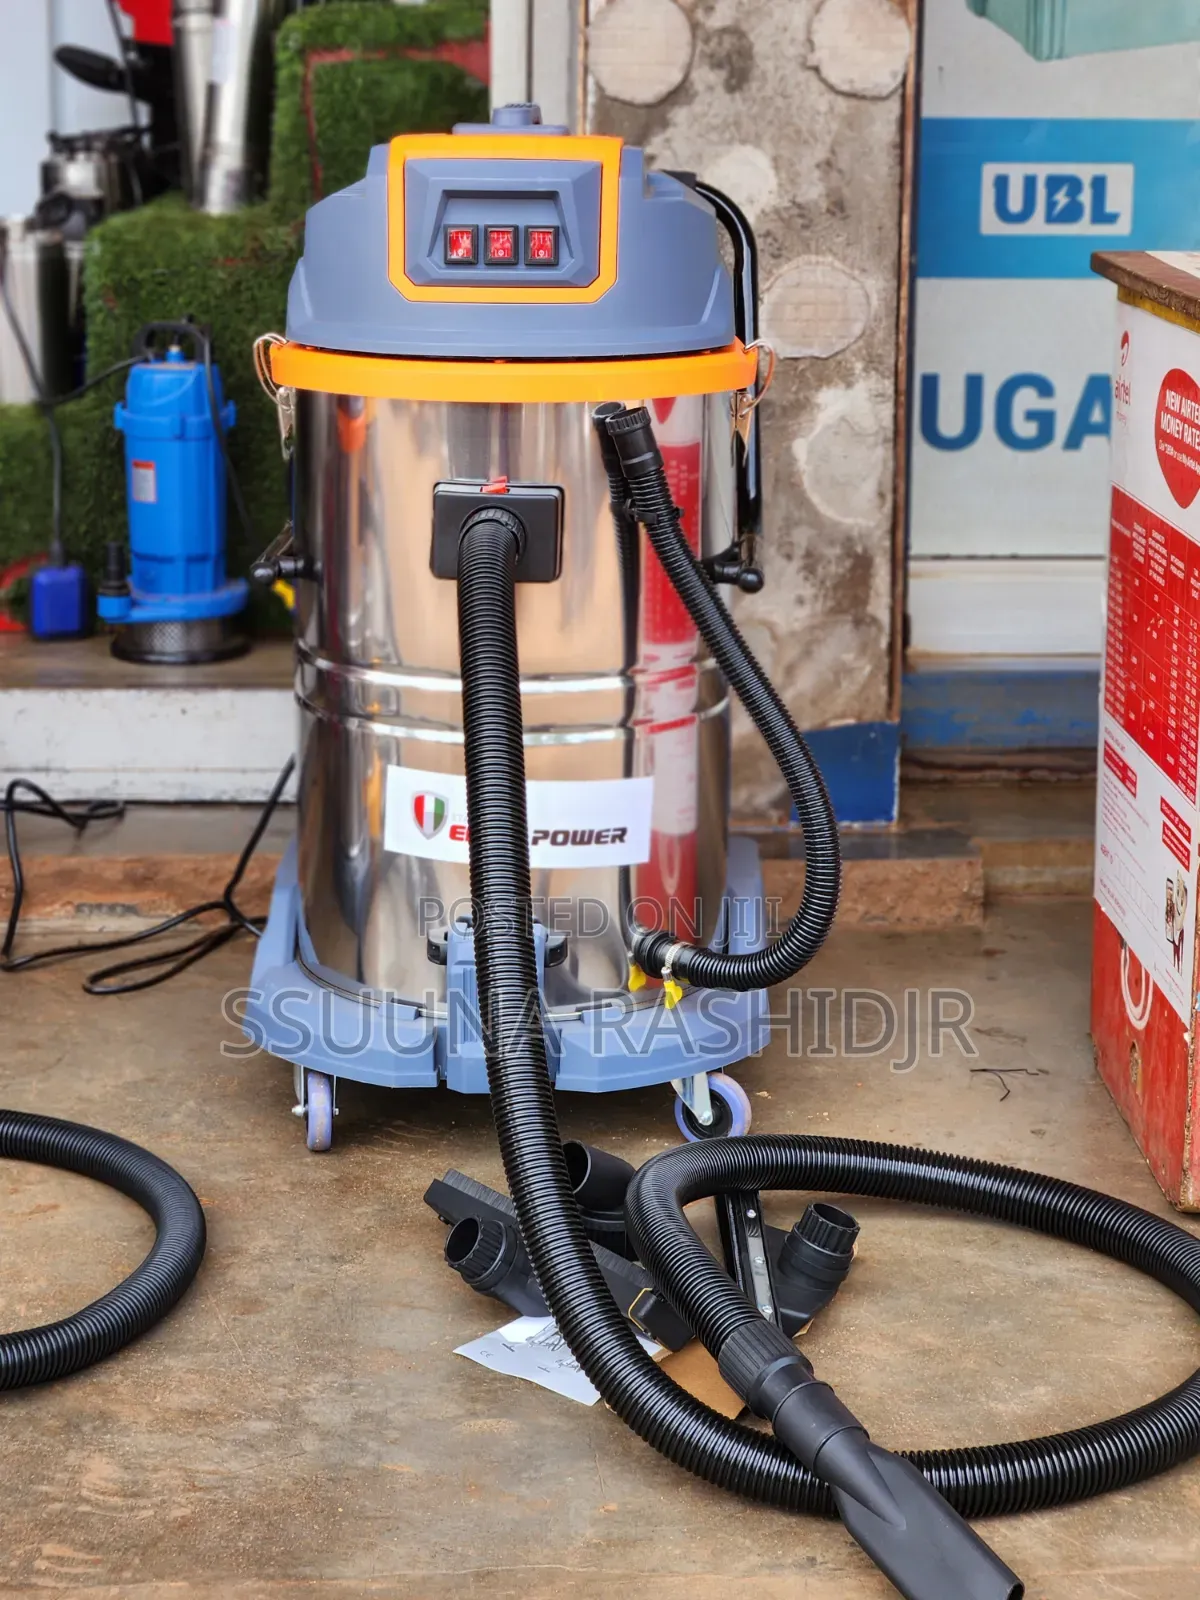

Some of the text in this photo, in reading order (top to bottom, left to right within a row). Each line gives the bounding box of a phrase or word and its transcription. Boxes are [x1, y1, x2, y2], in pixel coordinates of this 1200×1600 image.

[993, 173, 1120, 225] UBL
[1114, 375, 1130, 406] airtel
[1165, 389, 1180, 411] NEW
[919, 372, 1112, 452] UGA
[1160, 410, 1184, 439] MONEY
[1183, 423, 1200, 452] RATE
[531, 826, 628, 846] POWER
